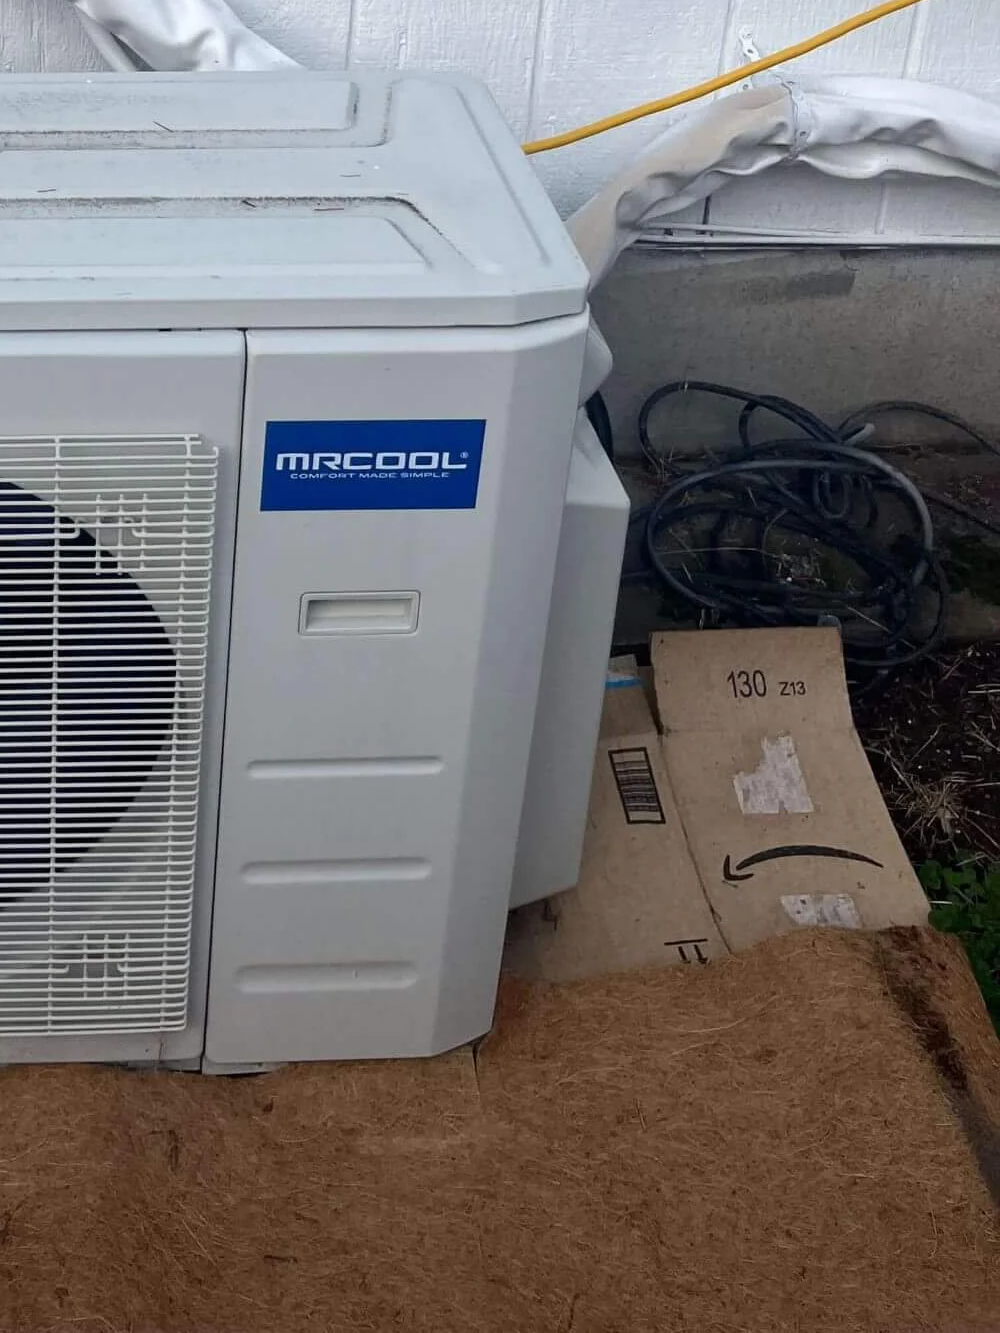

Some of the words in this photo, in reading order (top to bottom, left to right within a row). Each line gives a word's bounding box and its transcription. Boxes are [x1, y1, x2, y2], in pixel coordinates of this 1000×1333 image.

[289, 472, 354, 480] COMFORT
[727, 670, 767, 698] 130
[778, 681, 807, 696] Z13
